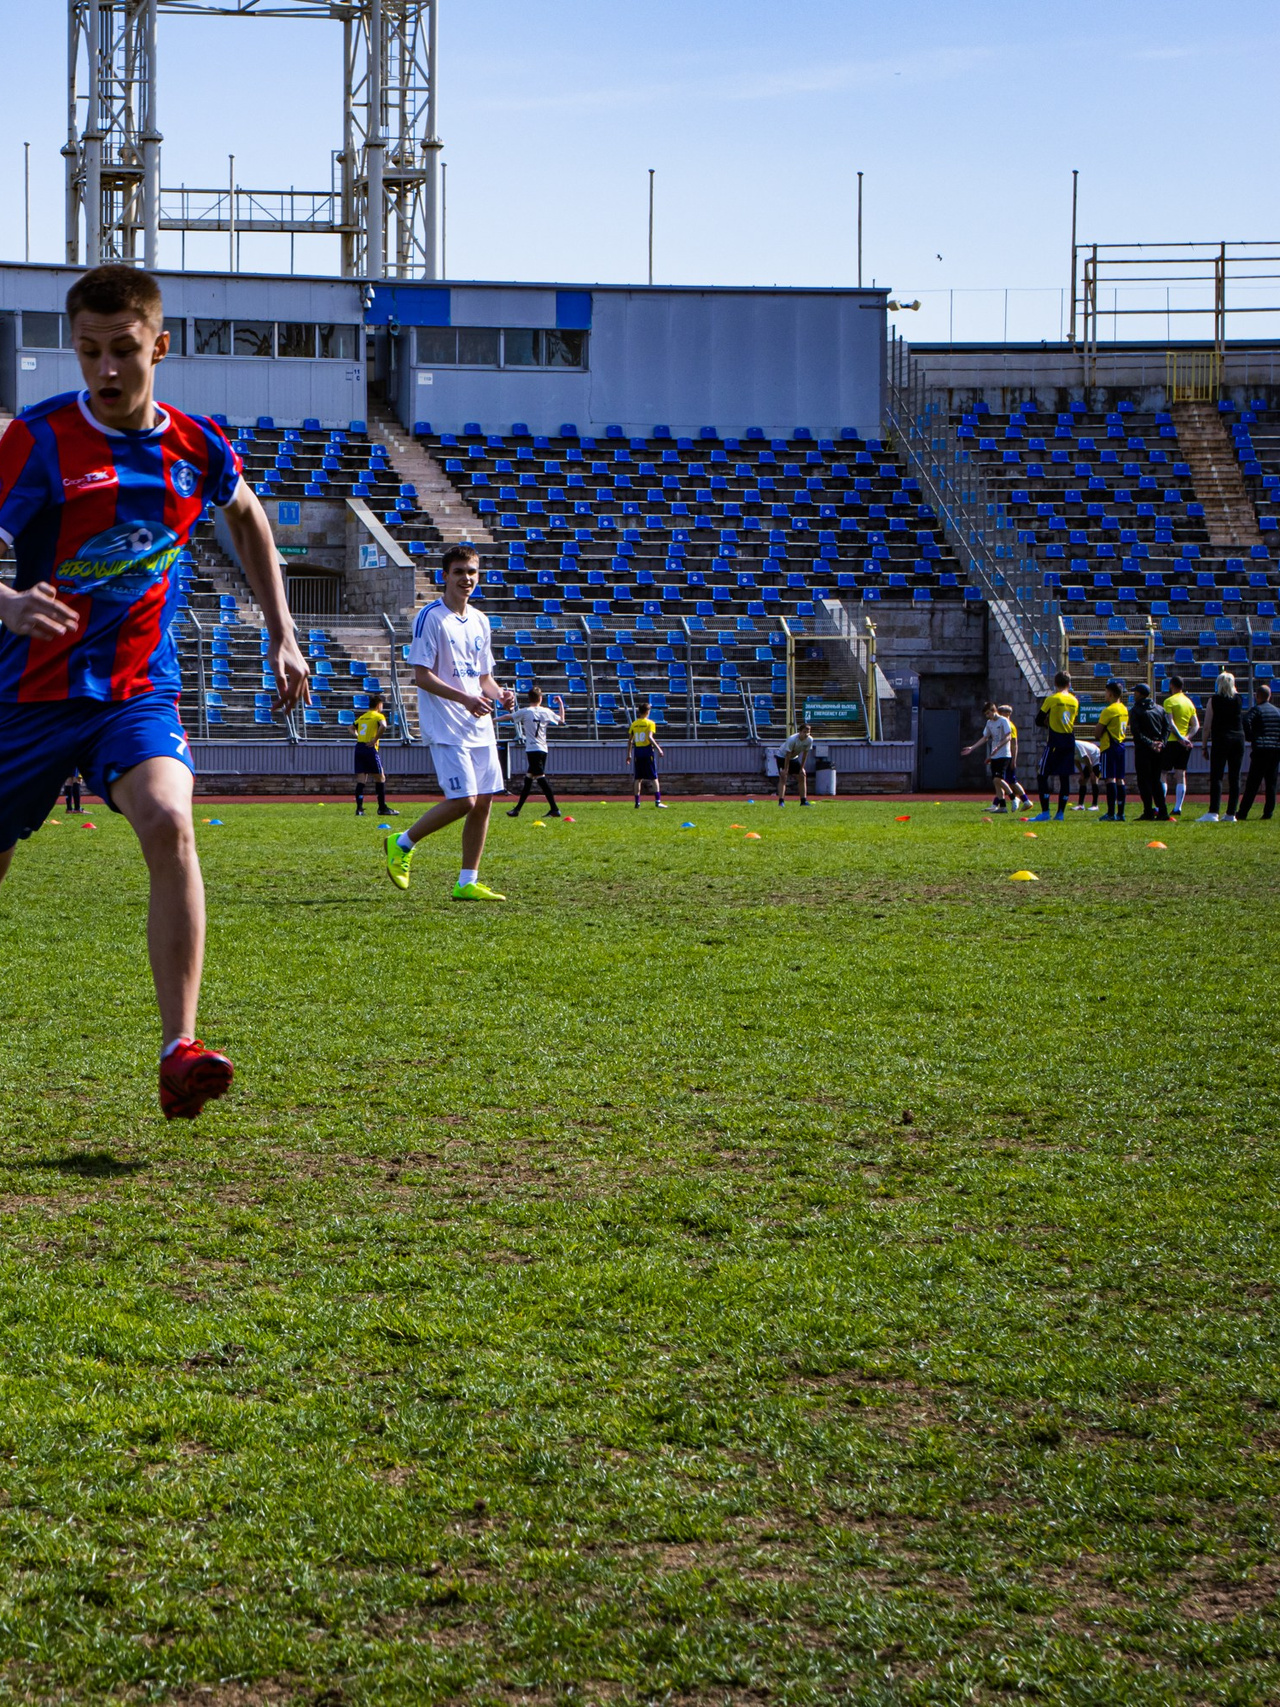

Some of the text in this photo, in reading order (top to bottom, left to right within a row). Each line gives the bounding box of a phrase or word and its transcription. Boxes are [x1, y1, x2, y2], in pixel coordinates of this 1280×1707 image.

[282, 507, 296, 518] 11
[360, 723, 368, 735] 2
[533, 719, 541, 737] 7
[170, 732, 187, 756] 7
[449, 777, 461, 790] 11
